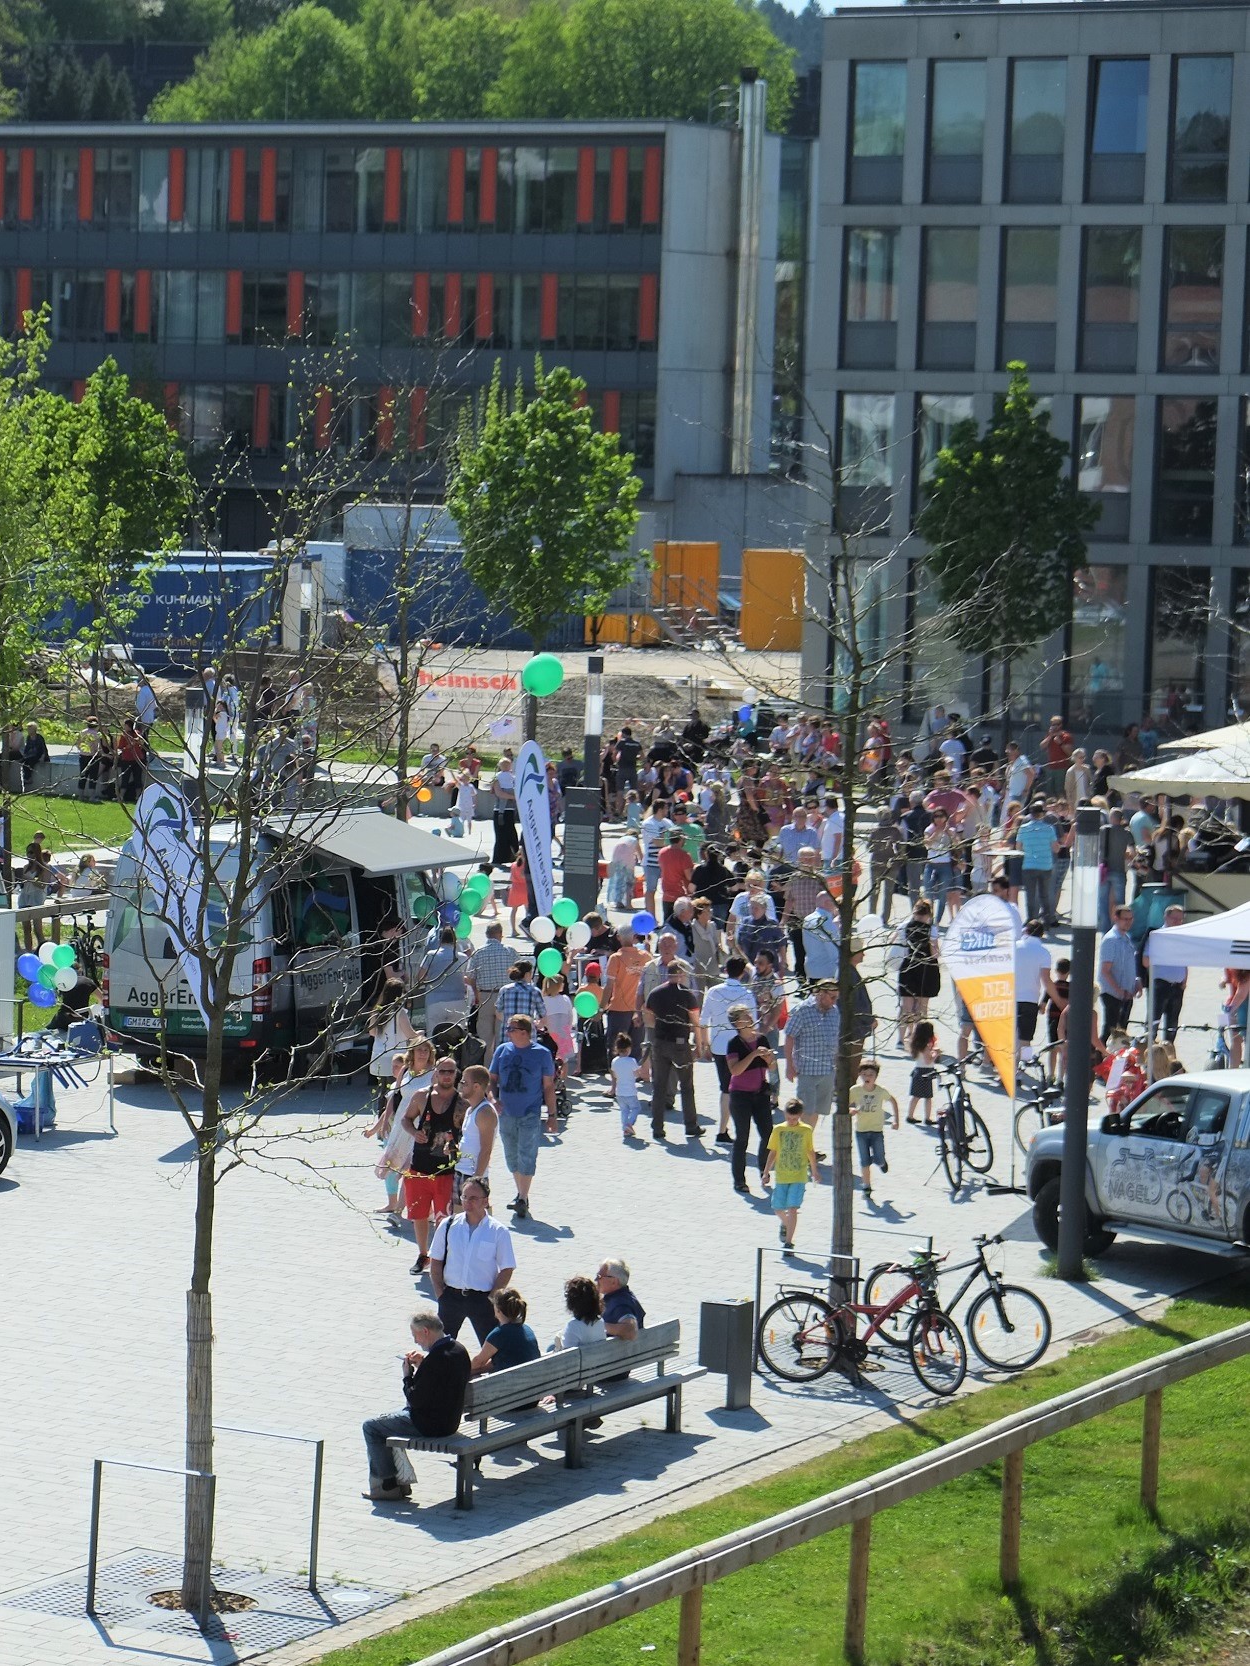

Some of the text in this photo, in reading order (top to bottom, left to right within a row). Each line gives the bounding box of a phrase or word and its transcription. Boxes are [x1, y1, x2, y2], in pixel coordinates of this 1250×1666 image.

[418, 669, 517, 691] heinisch
[527, 798, 549, 898] AggerEnergie
[127, 986, 198, 1007] AggerEn
[1108, 1179, 1151, 1204] NAGEL
